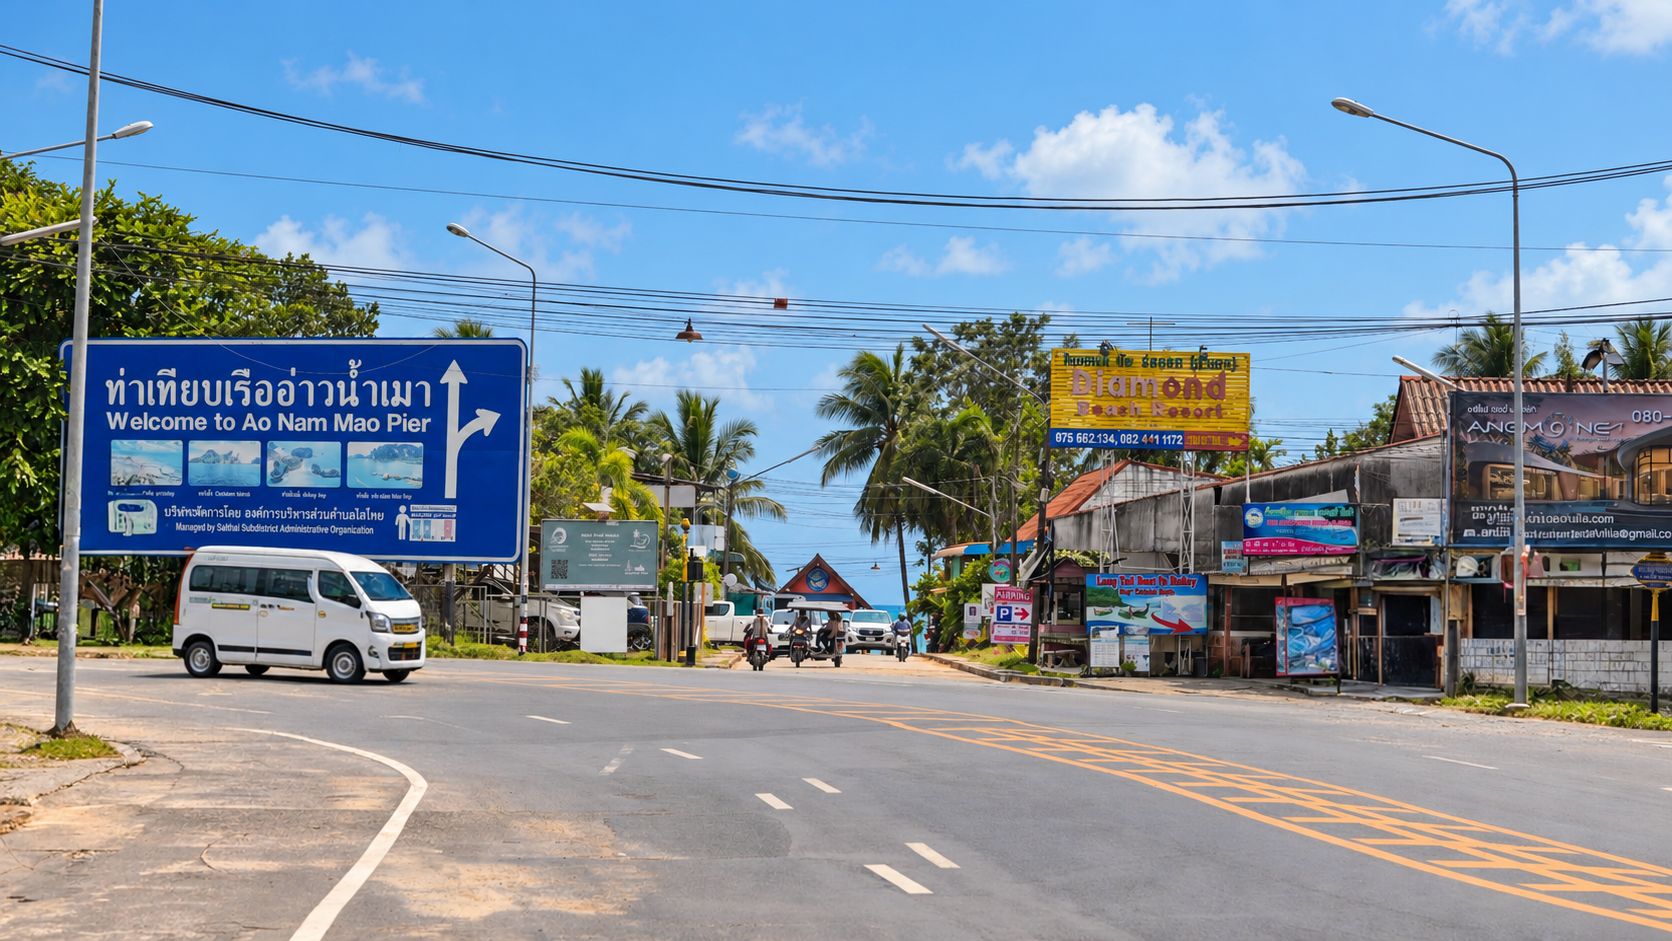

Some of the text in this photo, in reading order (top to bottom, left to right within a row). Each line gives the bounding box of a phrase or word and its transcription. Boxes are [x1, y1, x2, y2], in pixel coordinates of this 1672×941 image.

[1072, 369, 1226, 400] Diamond
[106, 411, 431, 433] Welcome to Ao Nam Mao Pier
[1120, 433, 1139, 444] 082
[1142, 434, 1159, 445] 441
[1162, 435, 1183, 446] 1172
[176, 522, 205, 533] Managed
[207, 523, 216, 534] by
[242, 523, 278, 533] Subdistrict
[279, 524, 329, 535] Administrative
[1000, 608, 1010, 619] P
